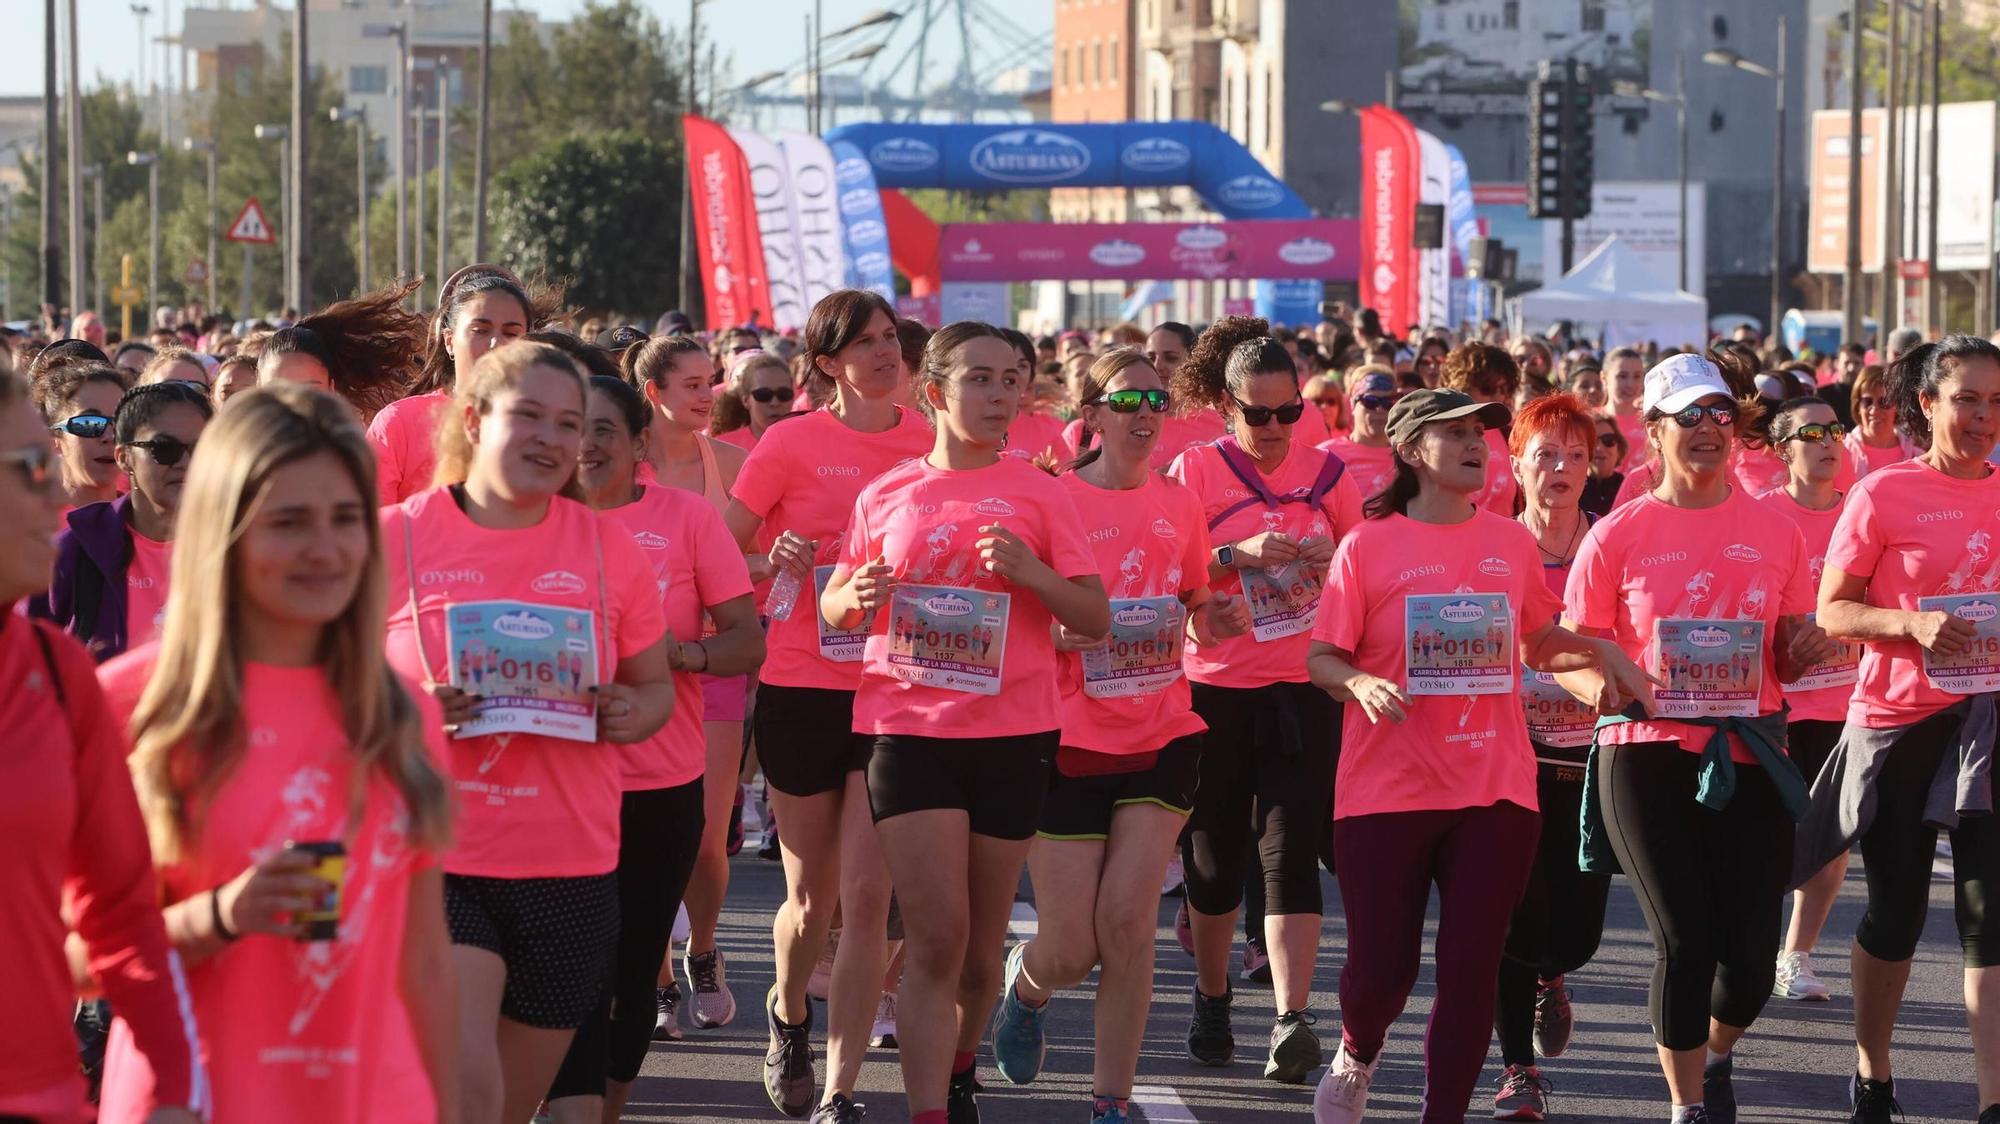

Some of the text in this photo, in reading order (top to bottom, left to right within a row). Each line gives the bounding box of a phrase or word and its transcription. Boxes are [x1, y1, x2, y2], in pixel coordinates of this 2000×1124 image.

[981, 146, 1081, 170] ASTURIANA
[817, 466, 860, 476] OYSHO
[1917, 510, 1963, 523] OYSHO
[1086, 527, 1119, 543] YSHO
[1641, 551, 1687, 567] OYSHO
[420, 570, 485, 585] OYSHO
[1400, 564, 1446, 580] OYSHO
[928, 600, 970, 613] ASTURIANA
[1117, 613, 1156, 623] ASTURIANA
[1442, 609, 1482, 619] ASTURIANA
[1958, 609, 1995, 618] ASTURIANA
[1265, 623, 1295, 635] OYSHO
[826, 636, 853, 644] CARRERA
[926, 630, 969, 650] 016
[1690, 633, 1729, 642] ASTURIANA
[1117, 640, 1154, 657] 016
[1443, 638, 1484, 655] 016
[934, 651, 955, 660] 1137
[1972, 657, 1989, 665] 1815
[893, 655, 920, 665] CARRERA
[940, 662, 960, 670] MUJER
[965, 665, 993, 675] VALENCIA
[1454, 659, 1473, 667] 1818
[501, 659, 554, 683] 016
[898, 667, 933, 681] OYSHO
[1690, 663, 1729, 679] 016
[1931, 668, 1958, 676] CARRERA
[955, 677, 987, 688] Santander
[1096, 682, 1127, 693] OYSHO
[1420, 680, 1455, 689] OYSHO
[1699, 683, 1718, 691] 1816
[1939, 680, 1973, 688] OYSHO
[1539, 699, 1577, 714] 016
[1664, 703, 1698, 712] OYSHO
